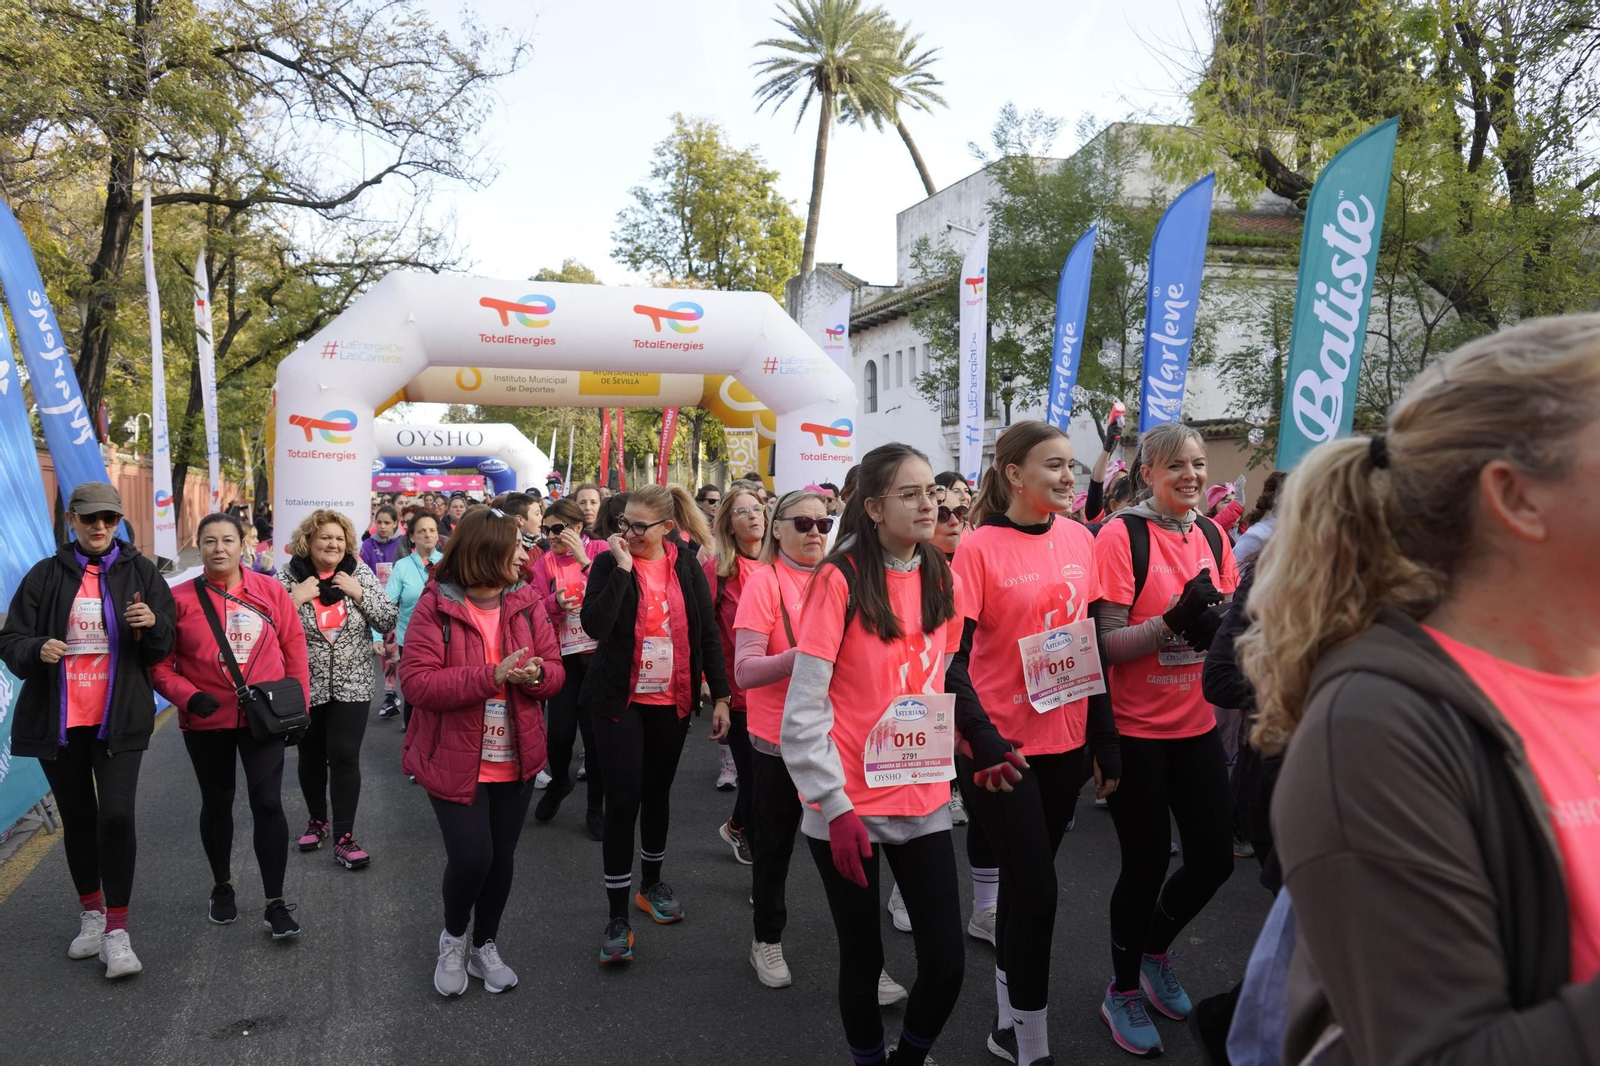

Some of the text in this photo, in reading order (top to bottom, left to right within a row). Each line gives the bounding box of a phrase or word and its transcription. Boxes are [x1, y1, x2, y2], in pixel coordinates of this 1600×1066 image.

[1293, 193, 1376, 443] Batiste
[479, 333, 556, 347] TotalEnergies
[633, 339, 704, 351] TotalEnergies
[1146, 282, 1190, 421] Marlene
[494, 374, 567, 385] Instituto Municipal
[518, 385, 555, 394] Deportes
[397, 429, 483, 447] OYSHO
[287, 449, 357, 462] TotalEnergies
[800, 453, 853, 463] TotalEnergies
[285, 498, 355, 508] totalenergies.es
[1150, 564, 1181, 573] OYSHO
[1004, 572, 1040, 587] OYSHO
[230, 632, 252, 642] 016
[1048, 656, 1075, 675] 016
[1146, 672, 1196, 685] CARRERA DE LA
[1072, 685, 1095, 696] Santander
[895, 708, 926, 717] ASTURIANA
[894, 731, 926, 748] 016
[874, 771, 945, 782] OYSHO Santander
